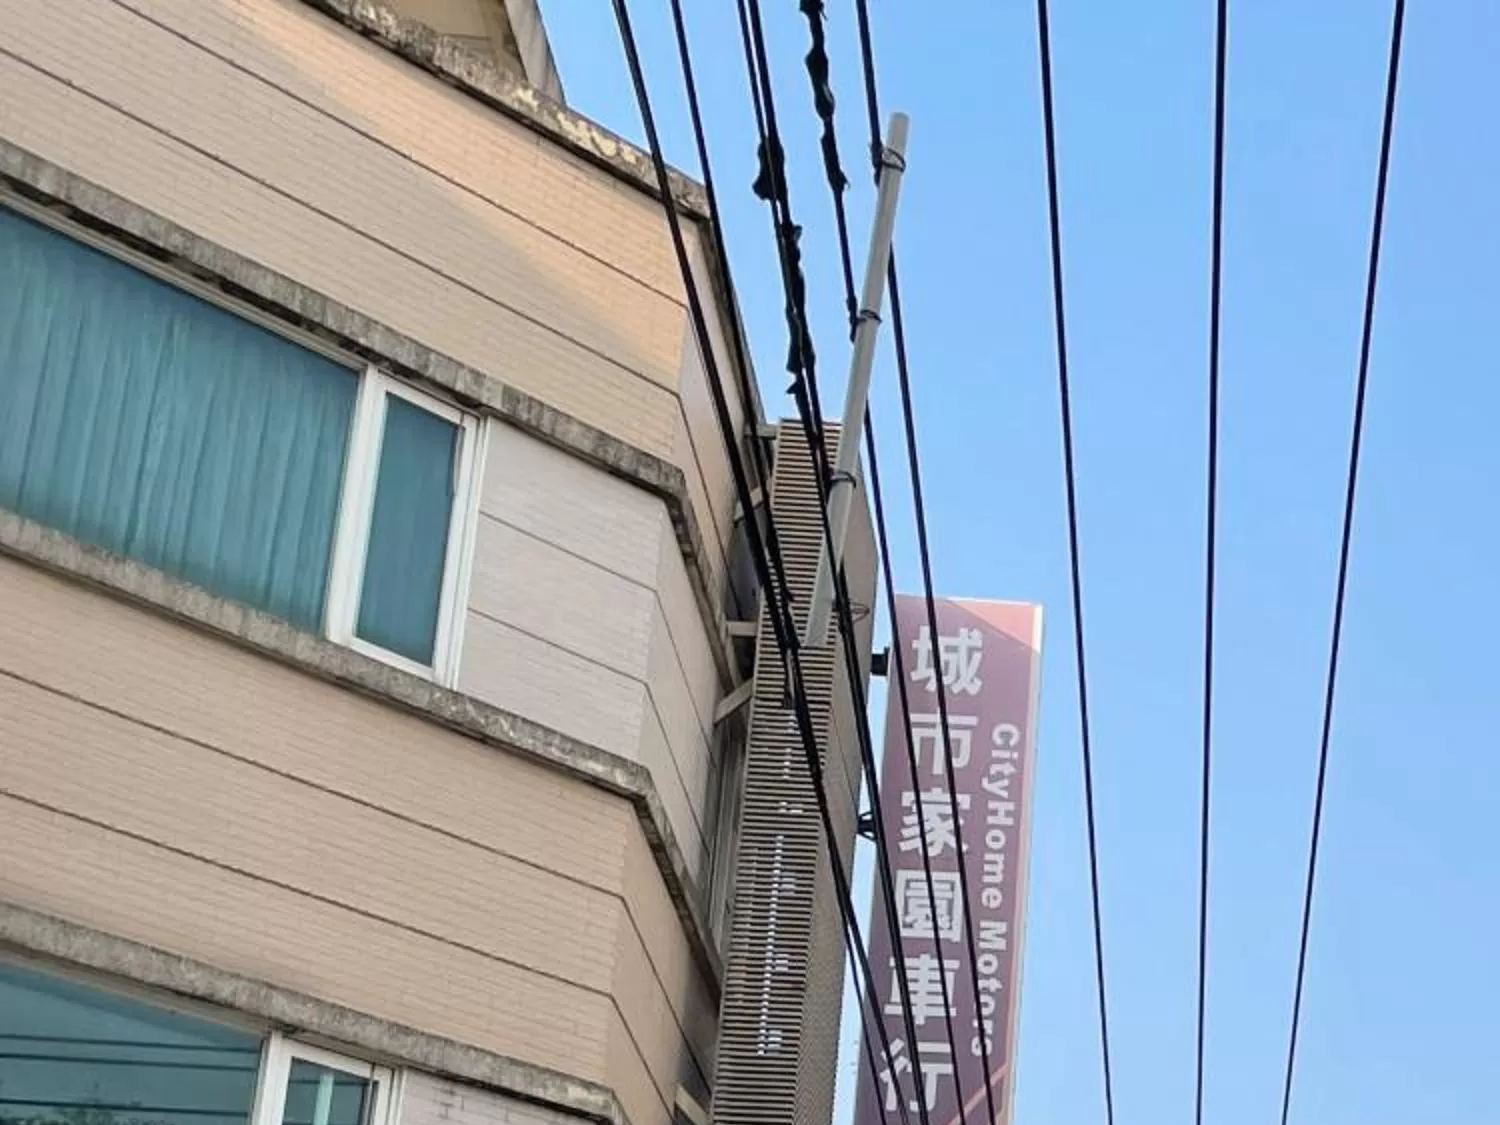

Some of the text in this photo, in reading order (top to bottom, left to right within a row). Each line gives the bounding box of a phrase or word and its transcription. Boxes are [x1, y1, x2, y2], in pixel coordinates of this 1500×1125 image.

[880, 625, 984, 1114] 城市家園車行
[980, 722, 1020, 908] CityHome
